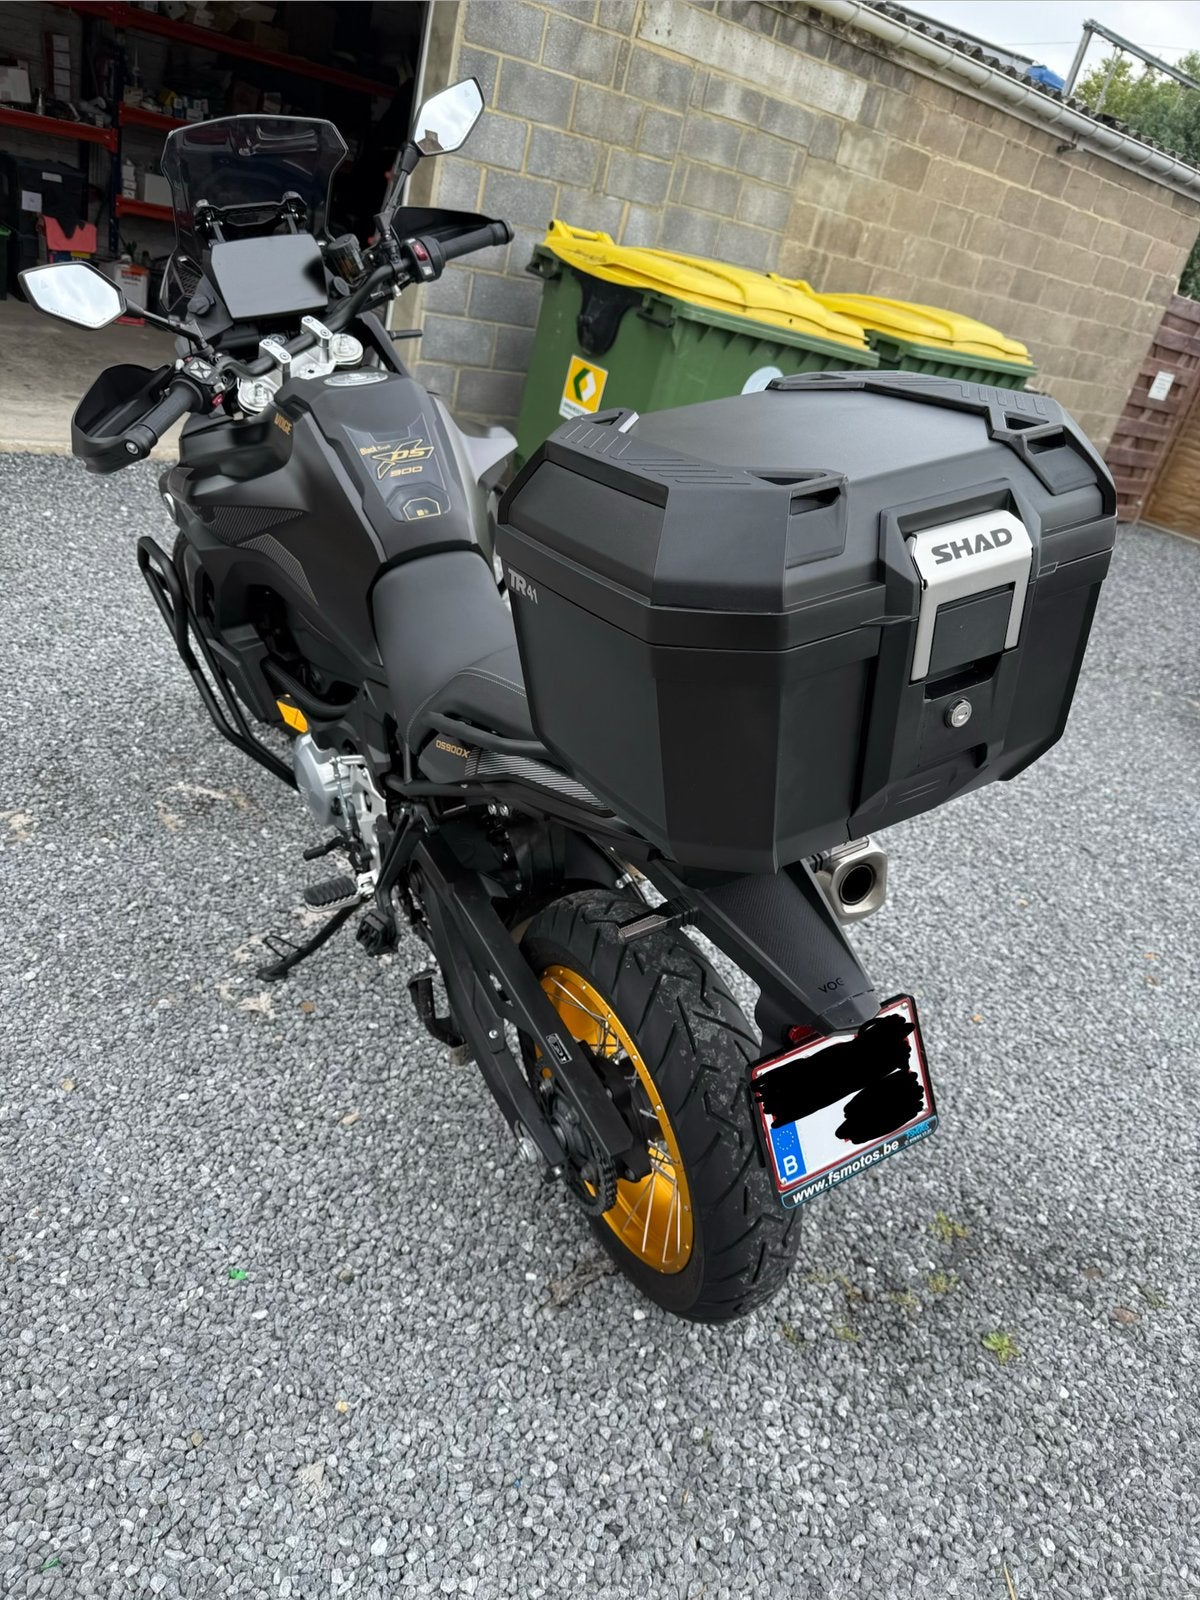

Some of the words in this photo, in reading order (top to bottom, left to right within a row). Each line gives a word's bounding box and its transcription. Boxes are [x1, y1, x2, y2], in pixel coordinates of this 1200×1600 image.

[390, 466, 422, 477] 900
[931, 528, 1012, 565] SHAD
[783, 1154, 799, 1177] B
[792, 1140, 899, 1204] www.fsmotos.be
